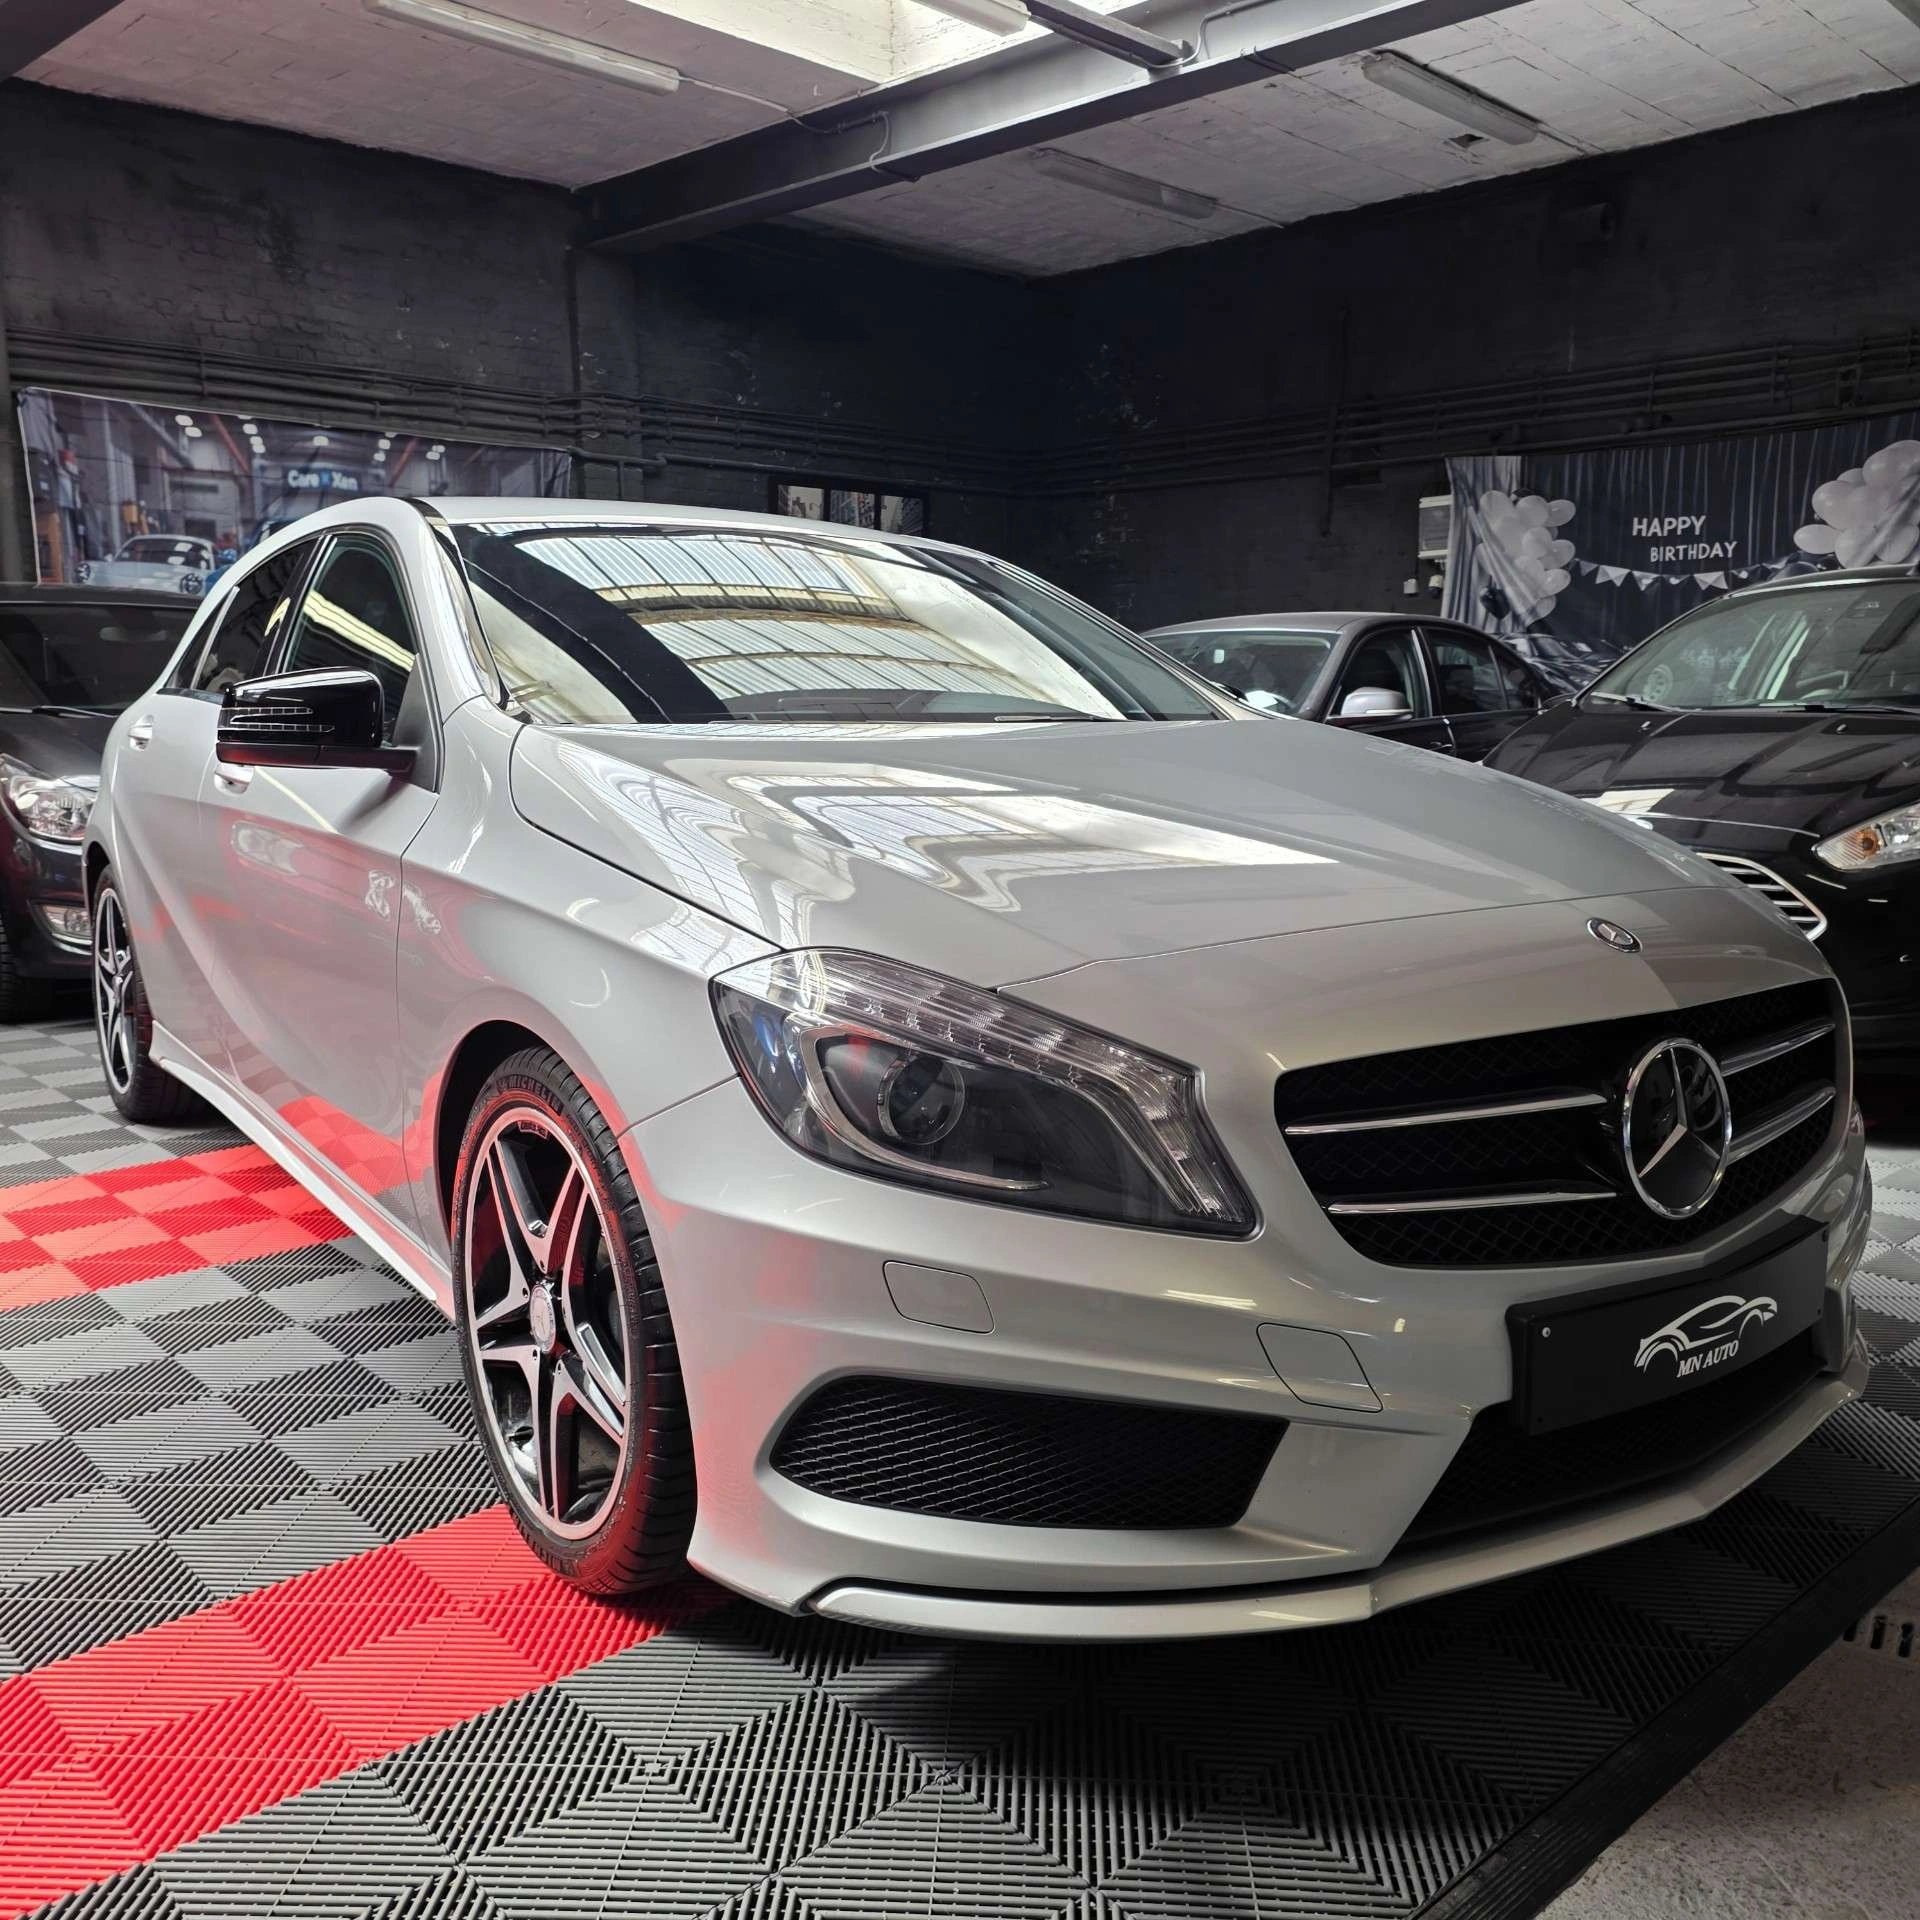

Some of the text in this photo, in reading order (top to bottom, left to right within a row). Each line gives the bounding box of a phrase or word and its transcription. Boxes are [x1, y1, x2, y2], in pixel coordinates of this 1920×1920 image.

[1632, 515, 1706, 537] HAPPY
[1650, 541, 1737, 562] BIRTHDAY
[1676, 1340, 1739, 1378] MN AUTO
